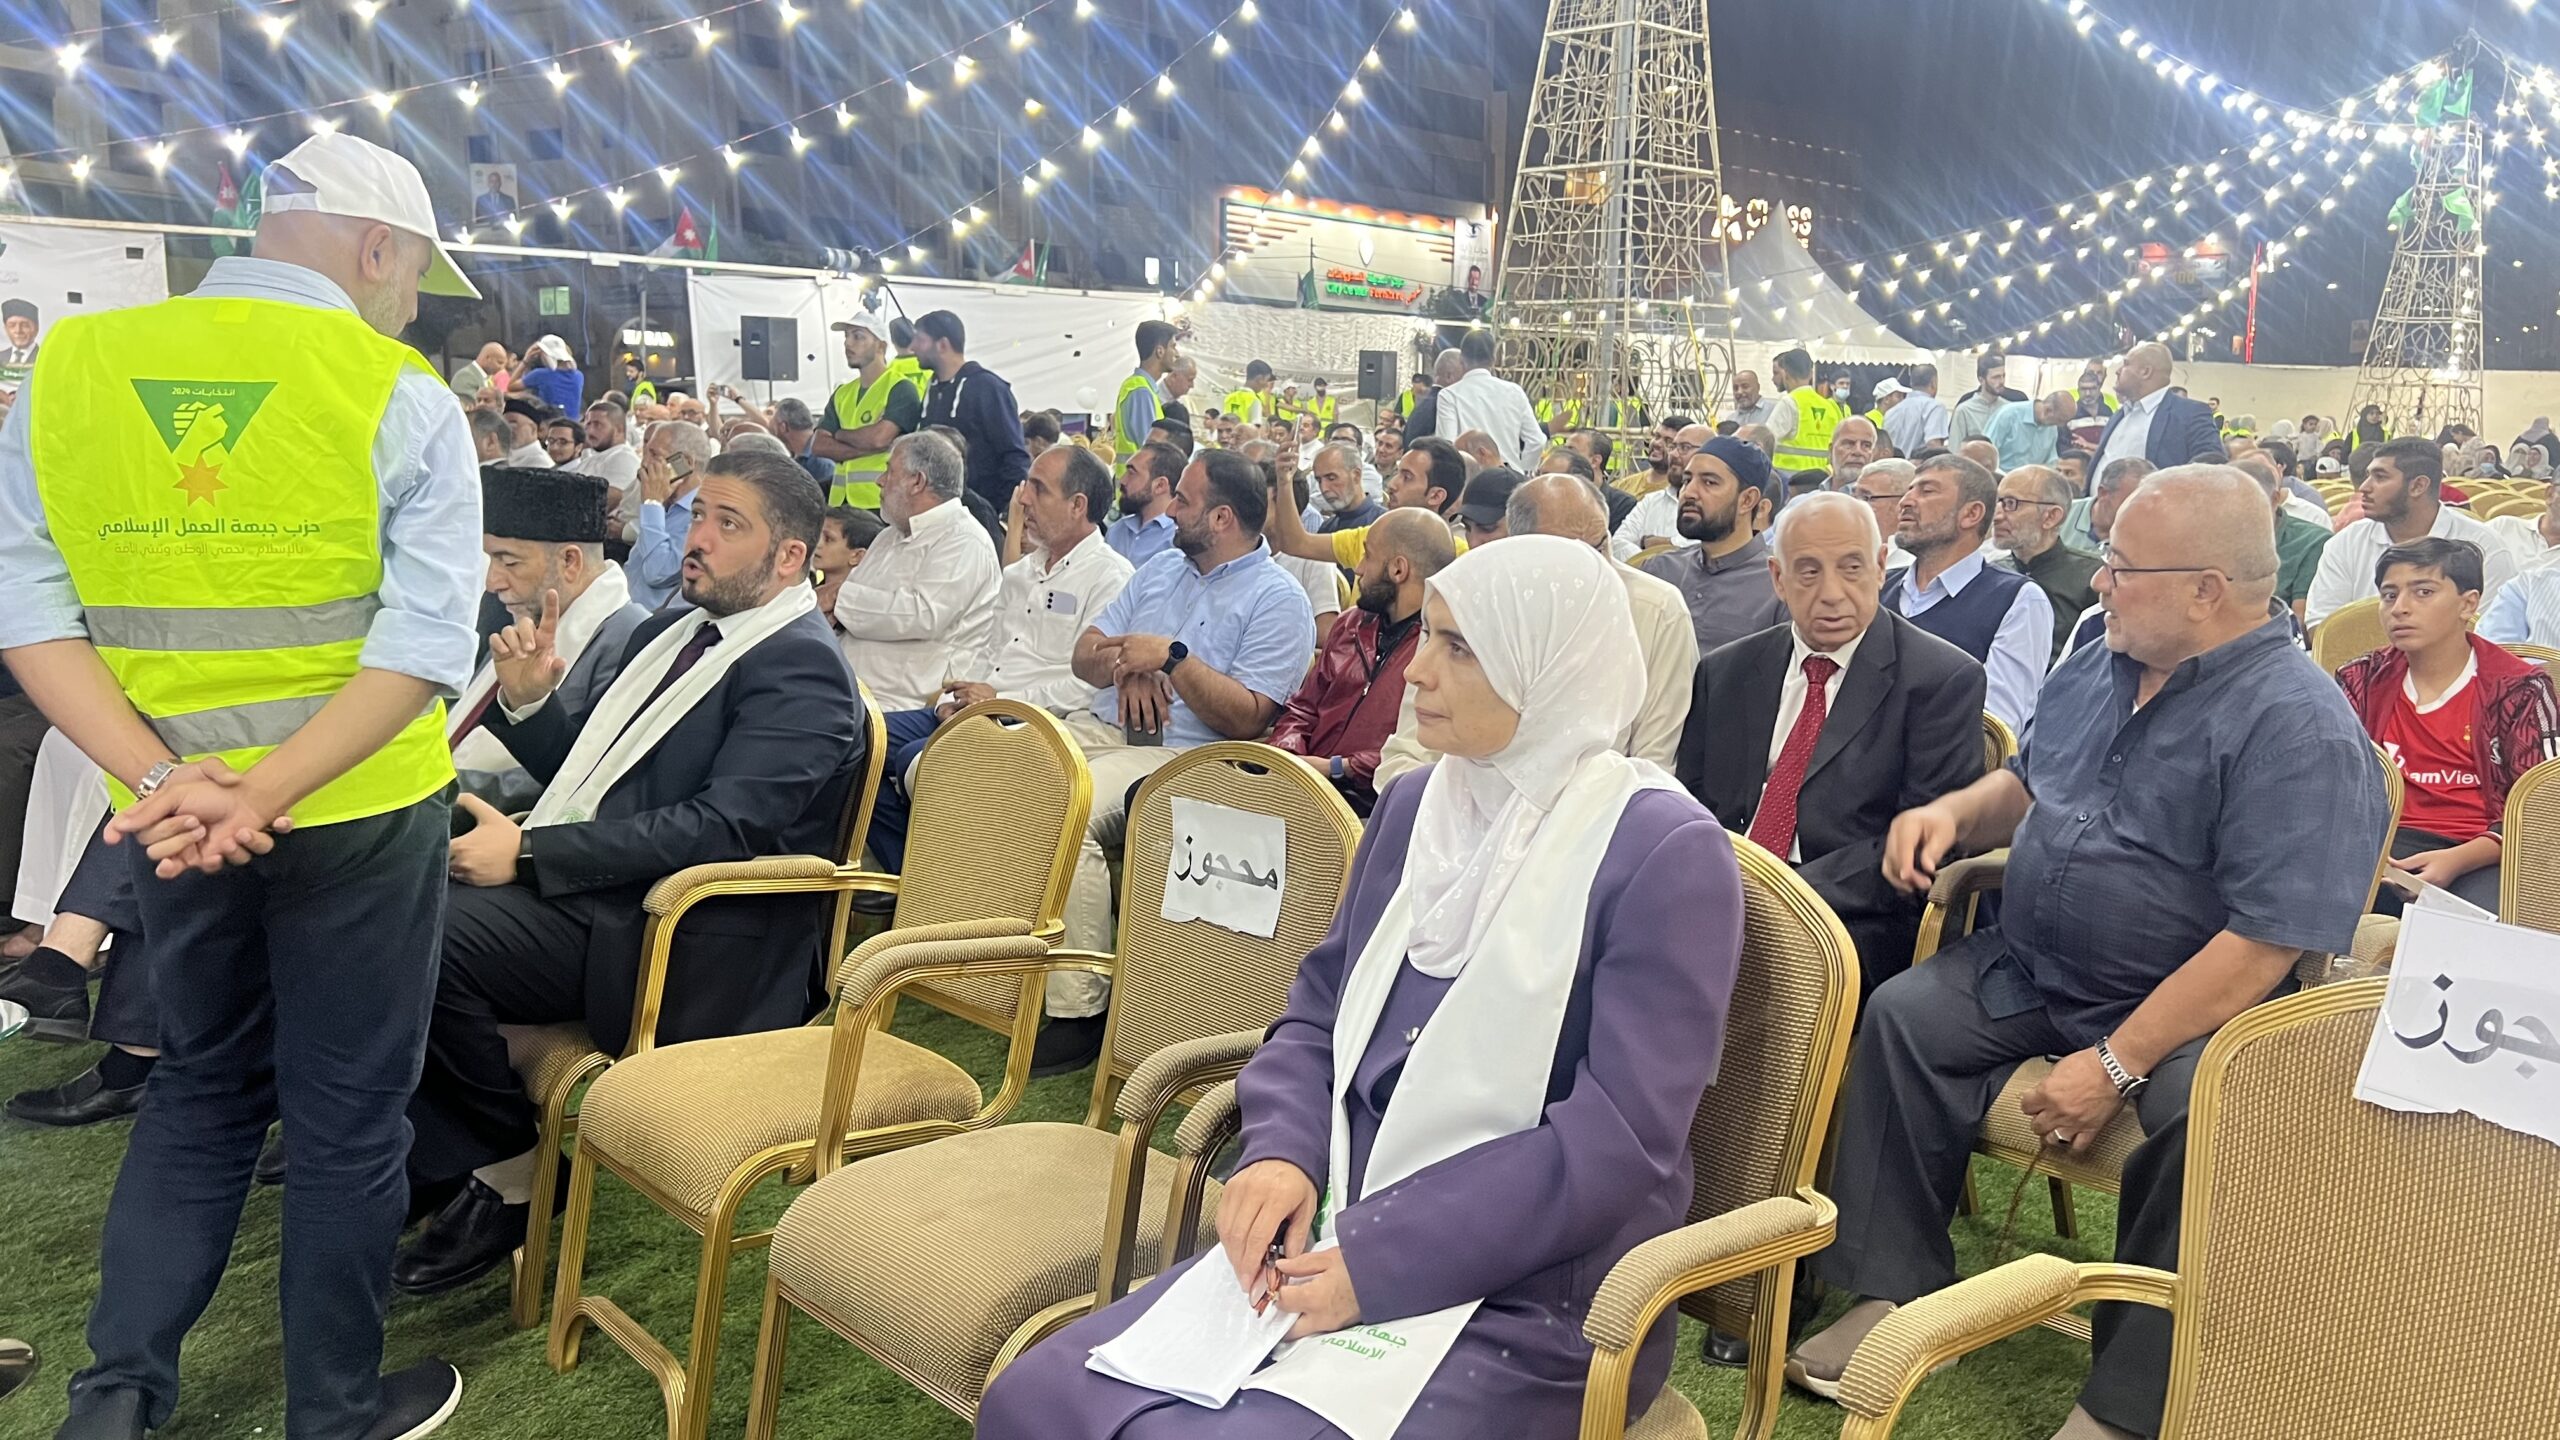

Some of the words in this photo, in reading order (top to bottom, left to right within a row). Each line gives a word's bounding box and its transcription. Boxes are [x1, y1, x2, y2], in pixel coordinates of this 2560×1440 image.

[171, 387, 191, 395] 2024
[192, 388, 236, 397] انتخابات
[97, 517, 170, 541] الإسلامي
[175, 518, 226, 537] العمل
[230, 518, 278, 538] جبهة
[283, 519, 321, 537] حزب
[1174, 835, 1278, 891] محجوز
[2384, 973, 2560, 1080] جوز
[1366, 1326, 1408, 1349] جبهة
